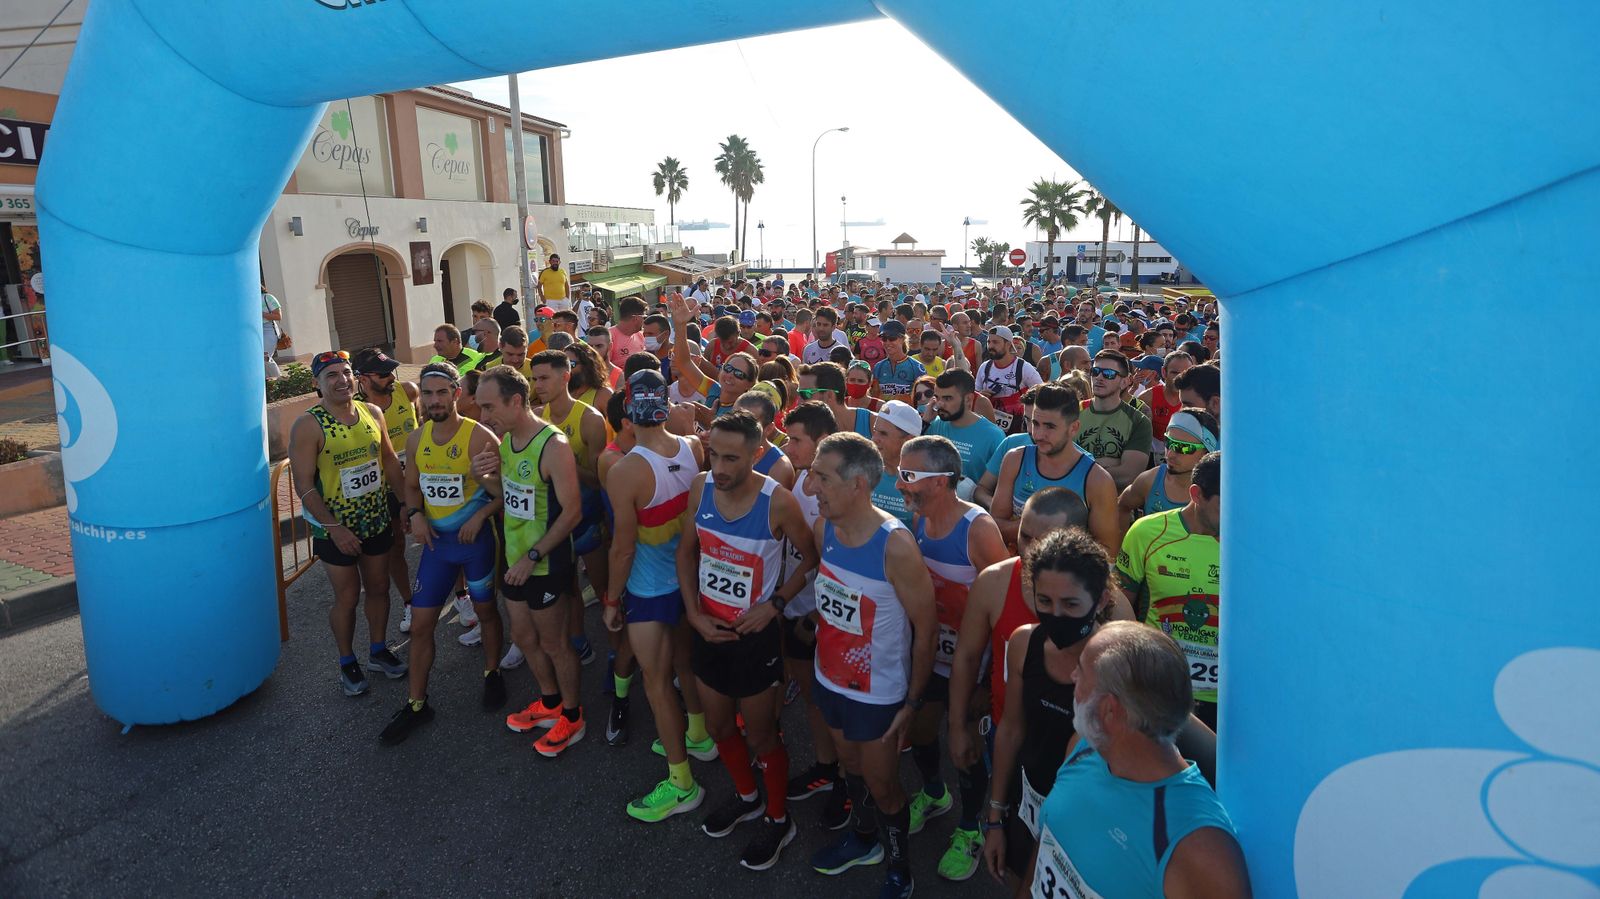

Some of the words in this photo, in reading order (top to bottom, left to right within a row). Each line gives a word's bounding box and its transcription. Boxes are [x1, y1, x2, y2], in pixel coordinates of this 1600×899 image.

[312, 124, 371, 170] Cepas
[426, 142, 471, 180] Cepas
[8, 198, 31, 209] 365
[344, 217, 380, 240] Cepas
[350, 470, 378, 489] 308
[426, 485, 461, 499] 362
[505, 490, 529, 512] 261
[707, 572, 746, 598] 226
[821, 594, 856, 622] 257
[1172, 623, 1216, 637] HORMIGAS
[1178, 631, 1208, 644] VERDES
